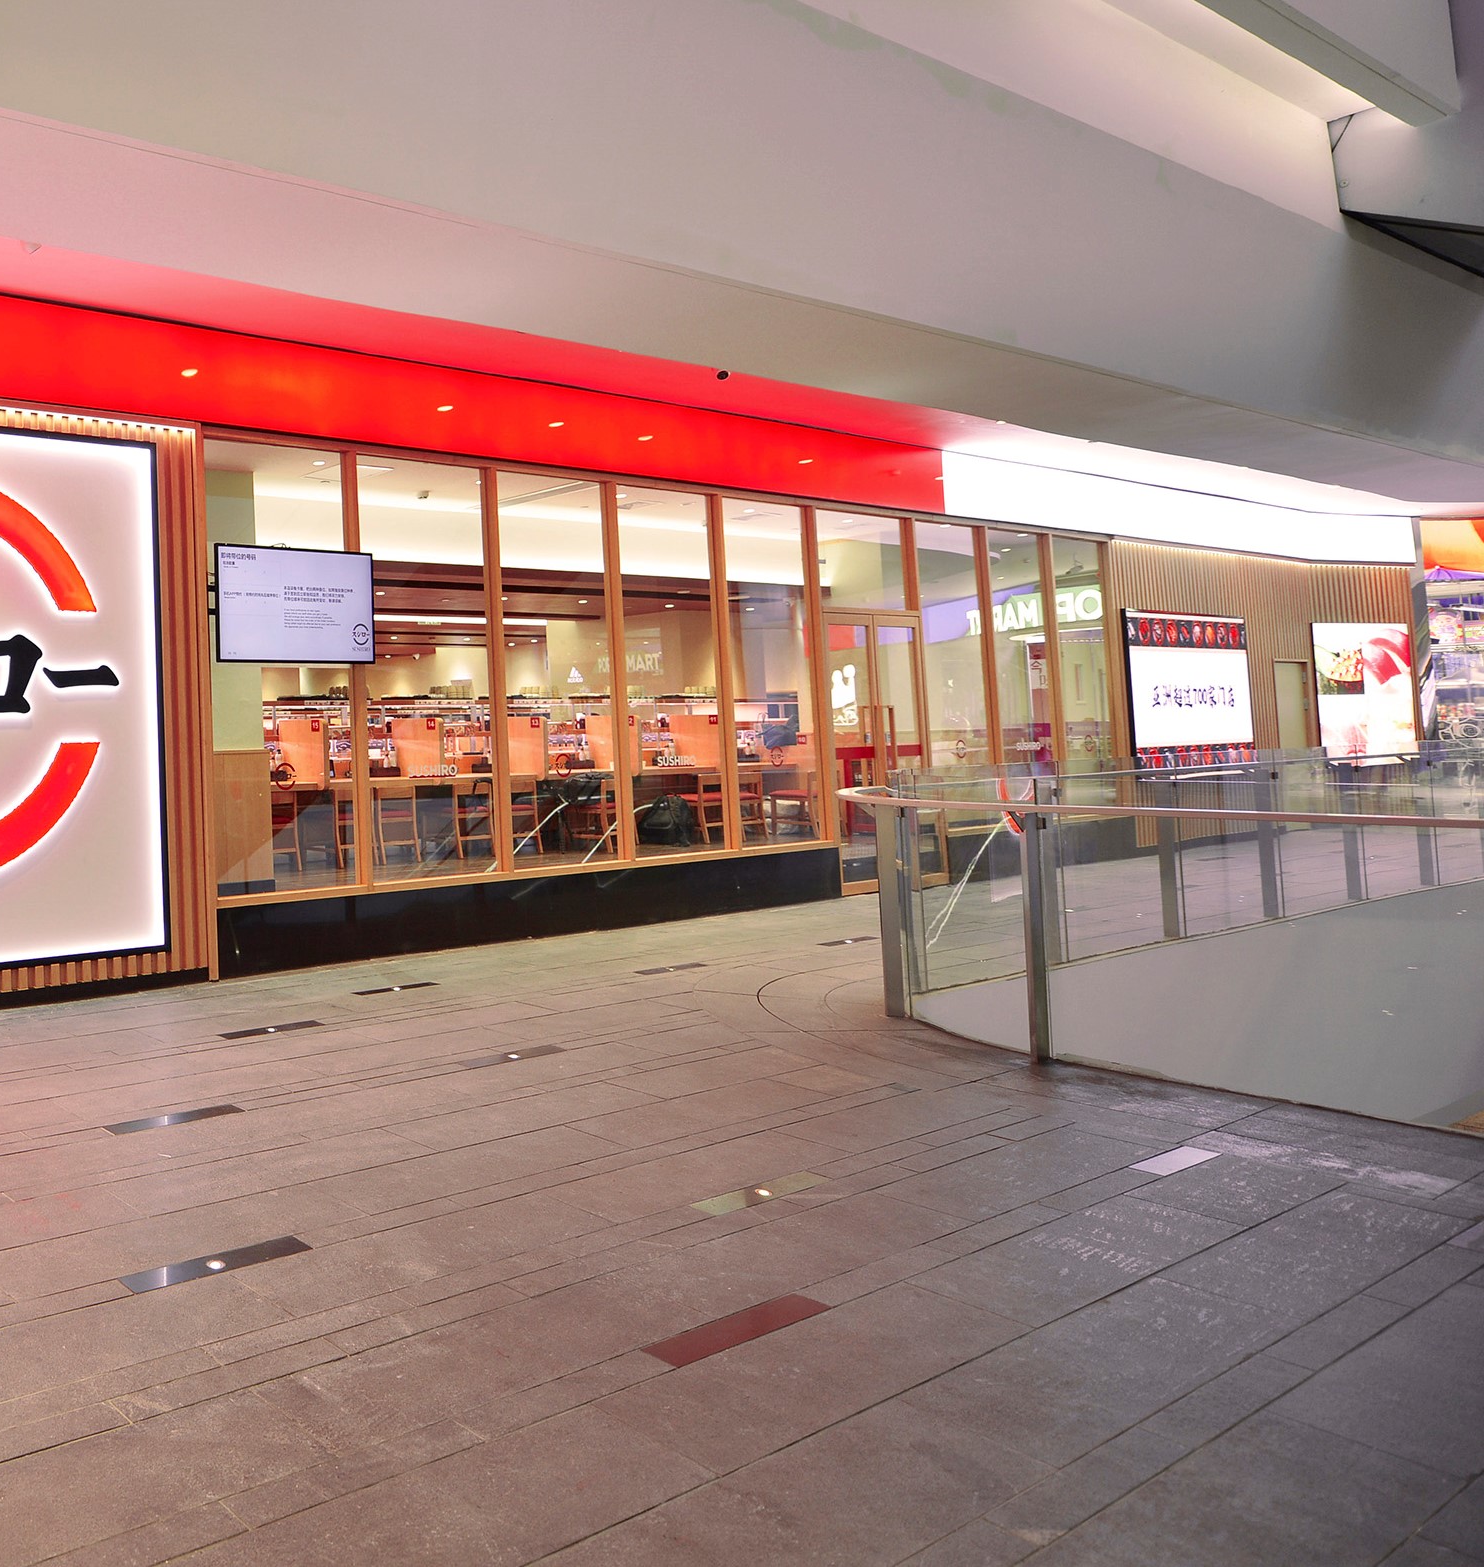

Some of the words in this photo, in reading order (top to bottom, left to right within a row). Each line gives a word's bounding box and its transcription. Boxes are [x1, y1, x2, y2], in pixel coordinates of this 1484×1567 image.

[626, 653, 660, 673] MART
[657, 755, 696, 767] SUSHIRO
[407, 764, 458, 778] SUSHIRO
